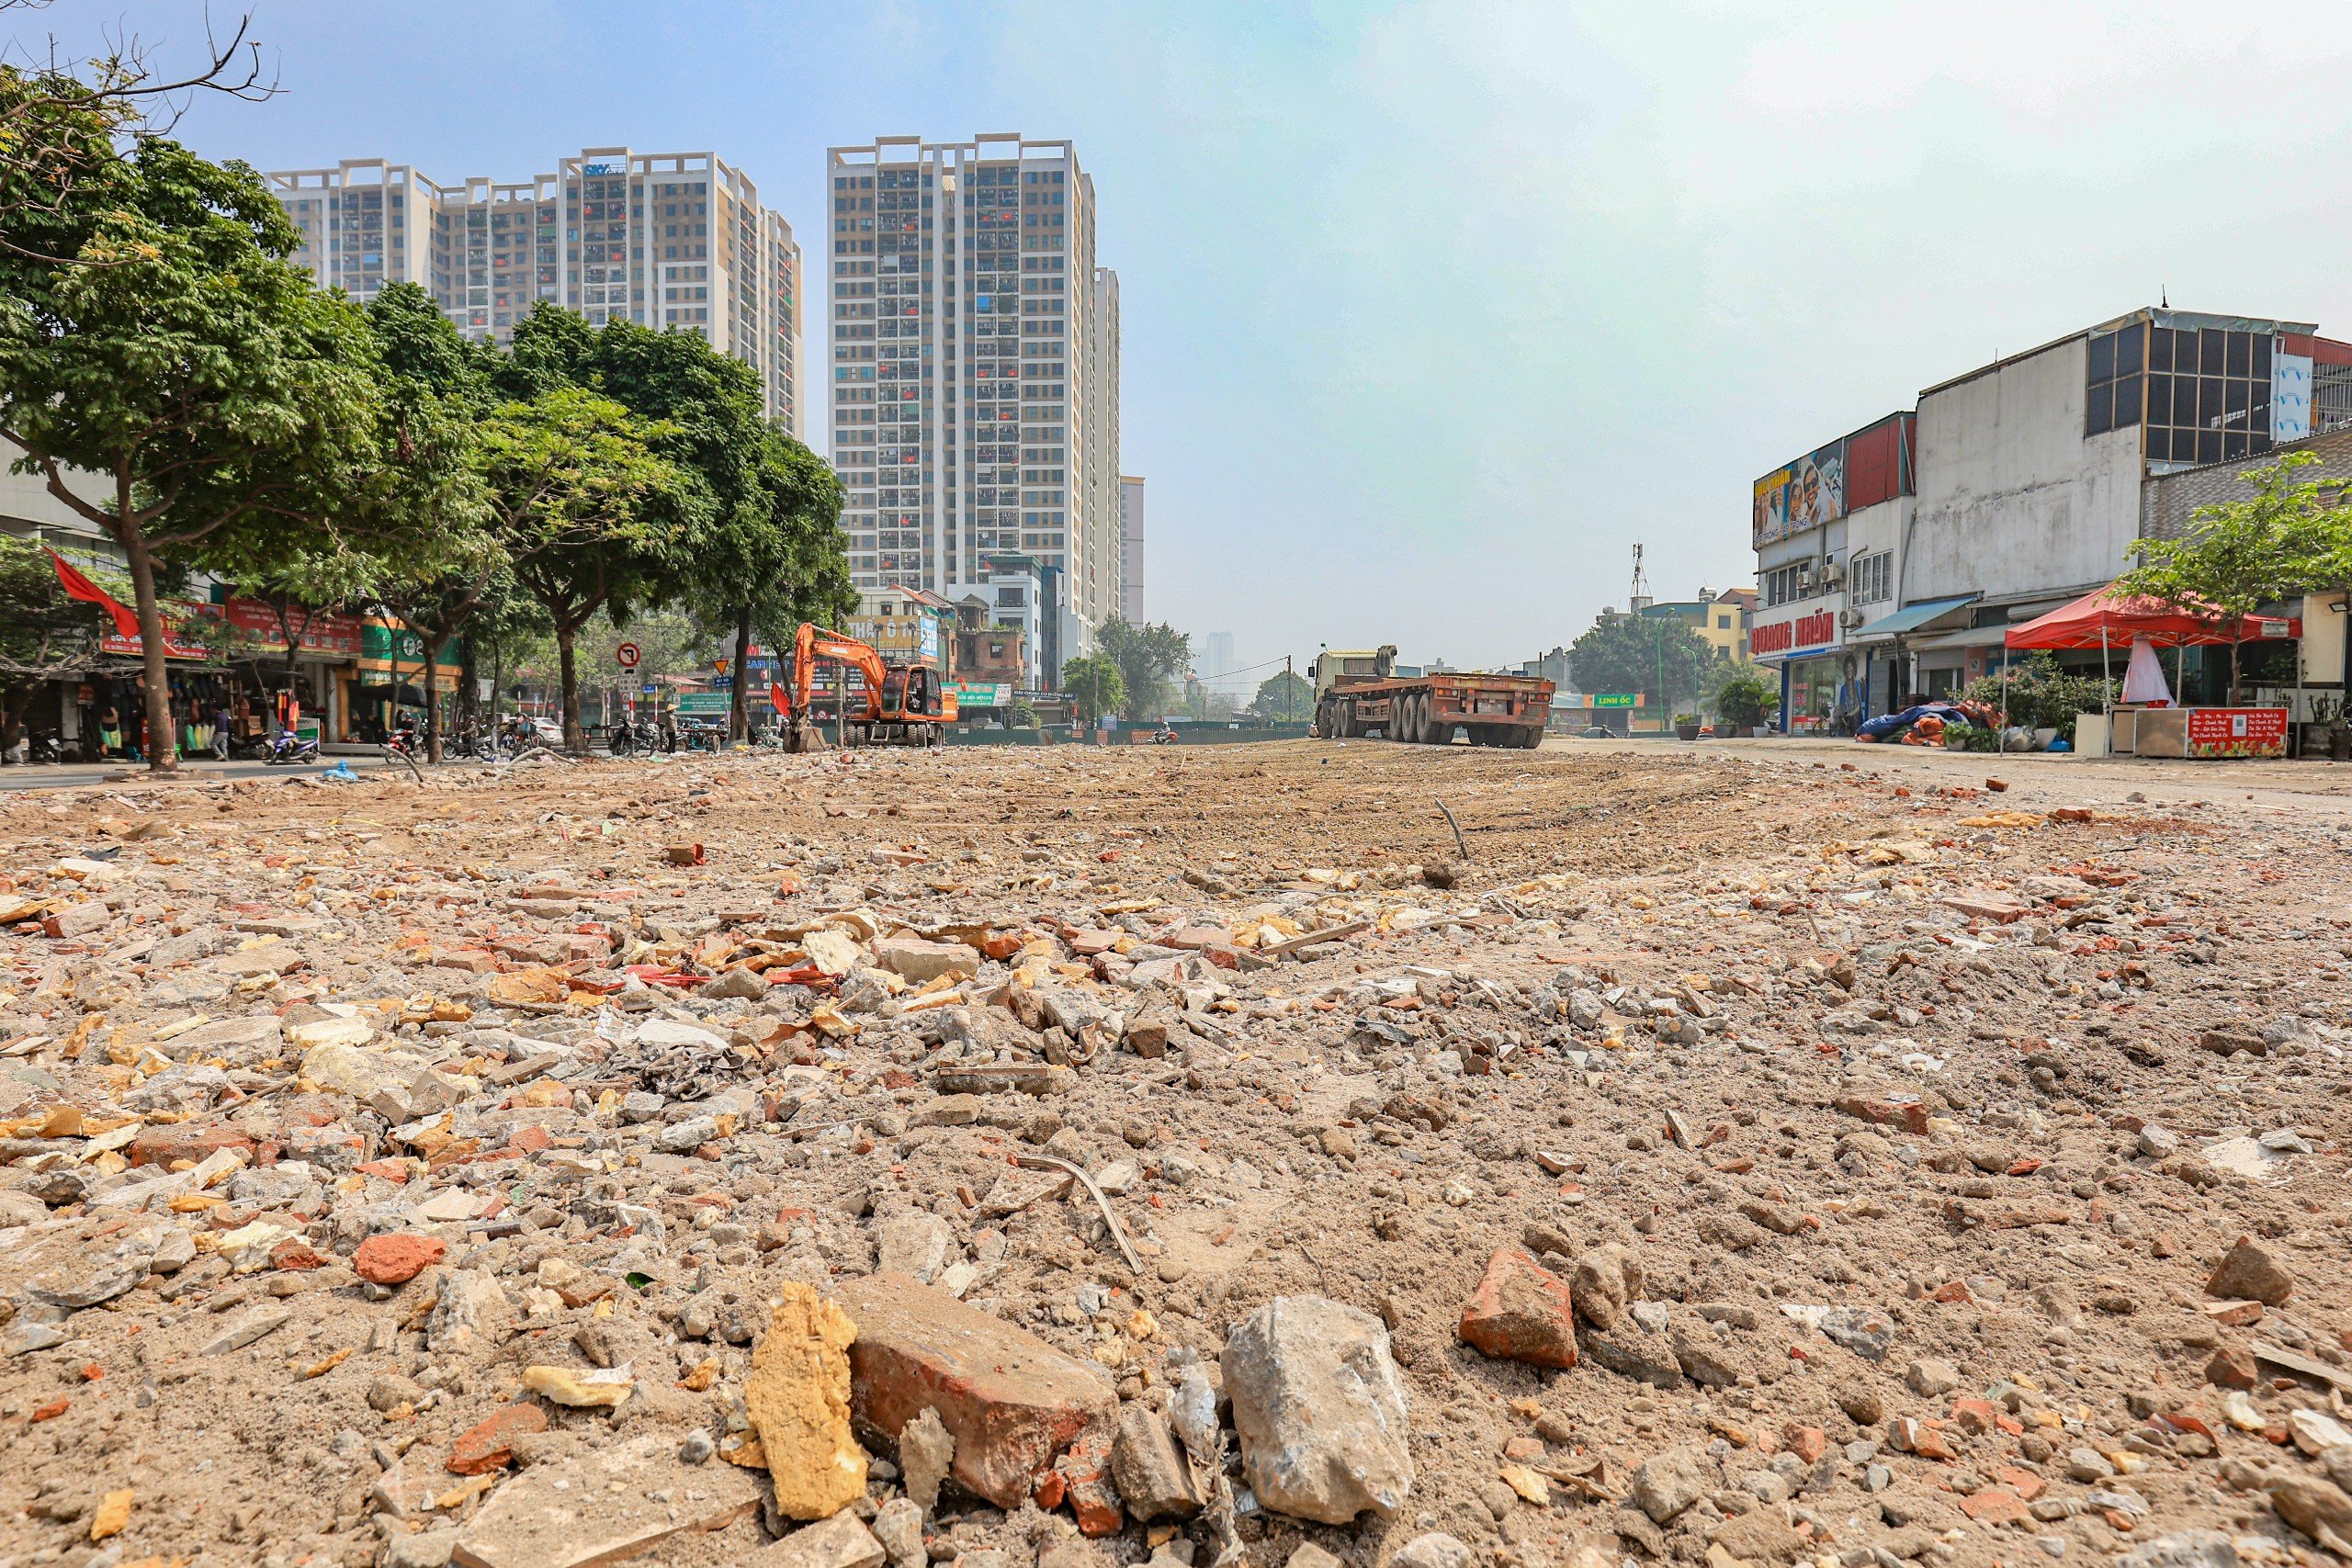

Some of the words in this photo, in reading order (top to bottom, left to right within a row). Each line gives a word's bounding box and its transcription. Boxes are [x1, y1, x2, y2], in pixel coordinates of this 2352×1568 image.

[887, 618, 897, 638] Ô
[1752, 621, 1792, 655] QUANG
[1620, 694, 1631, 704] ỐC
